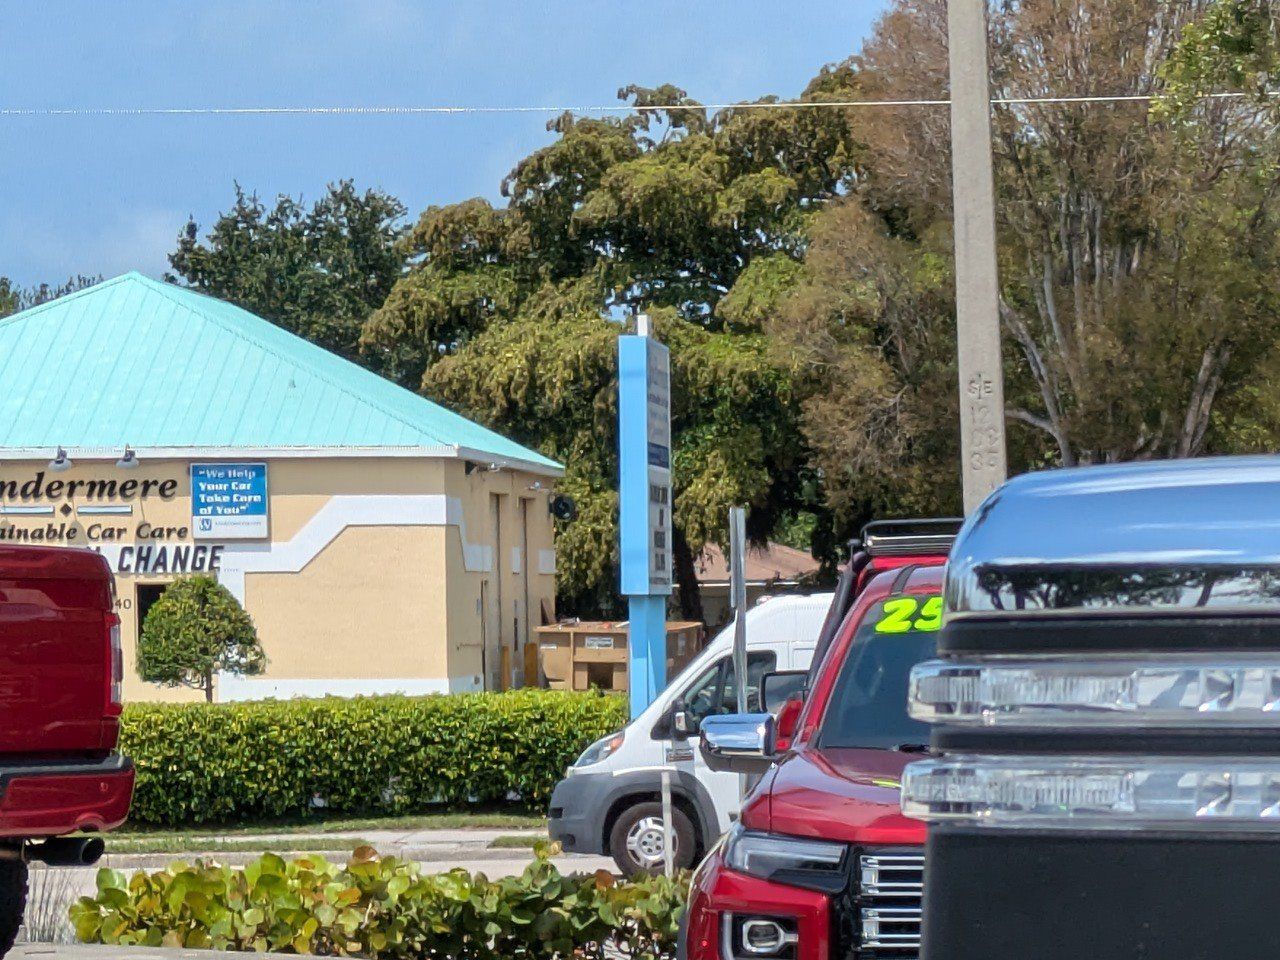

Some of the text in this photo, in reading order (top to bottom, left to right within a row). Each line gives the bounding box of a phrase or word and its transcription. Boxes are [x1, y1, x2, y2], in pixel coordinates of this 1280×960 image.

[228, 469, 256, 480] Help
[199, 481, 252, 491] Your Car
[199, 494, 262, 503] Take Care
[199, 507, 213, 515] of
[87, 523, 128, 540] Car
[136, 522, 189, 540] Care
[117, 545, 225, 574] CHANGE
